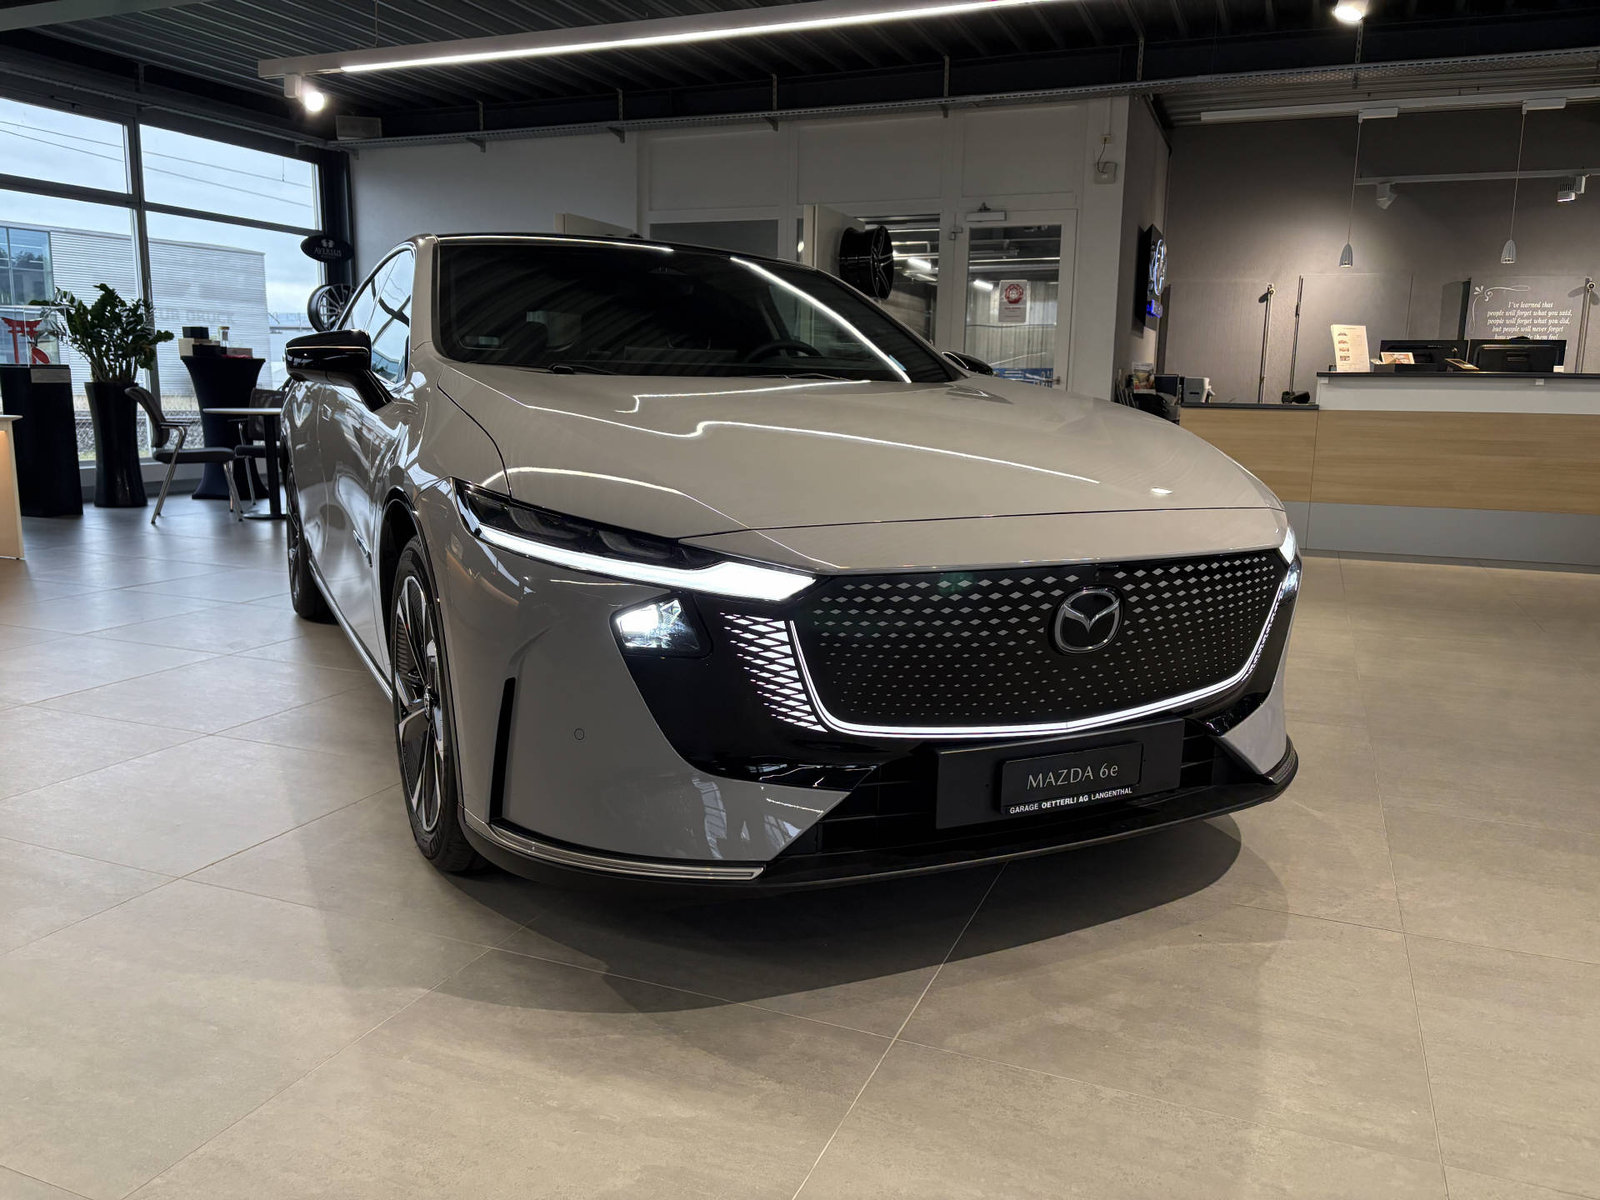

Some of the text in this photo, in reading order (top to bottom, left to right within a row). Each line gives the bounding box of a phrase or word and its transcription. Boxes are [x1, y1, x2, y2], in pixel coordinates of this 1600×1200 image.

[1487, 310, 1505, 318] people
[1516, 310, 1532, 318] forget
[1487, 318, 1505, 326] people
[1516, 318, 1532, 326] forget
[1503, 326, 1519, 334] people
[1548, 326, 1563, 334] forget
[1027, 763, 1118, 790] MAZDA 6e
[1010, 803, 1039, 814] GARAGE
[1041, 797, 1077, 809] OETTERLI
[1091, 787, 1133, 800] LANGENTHAL
